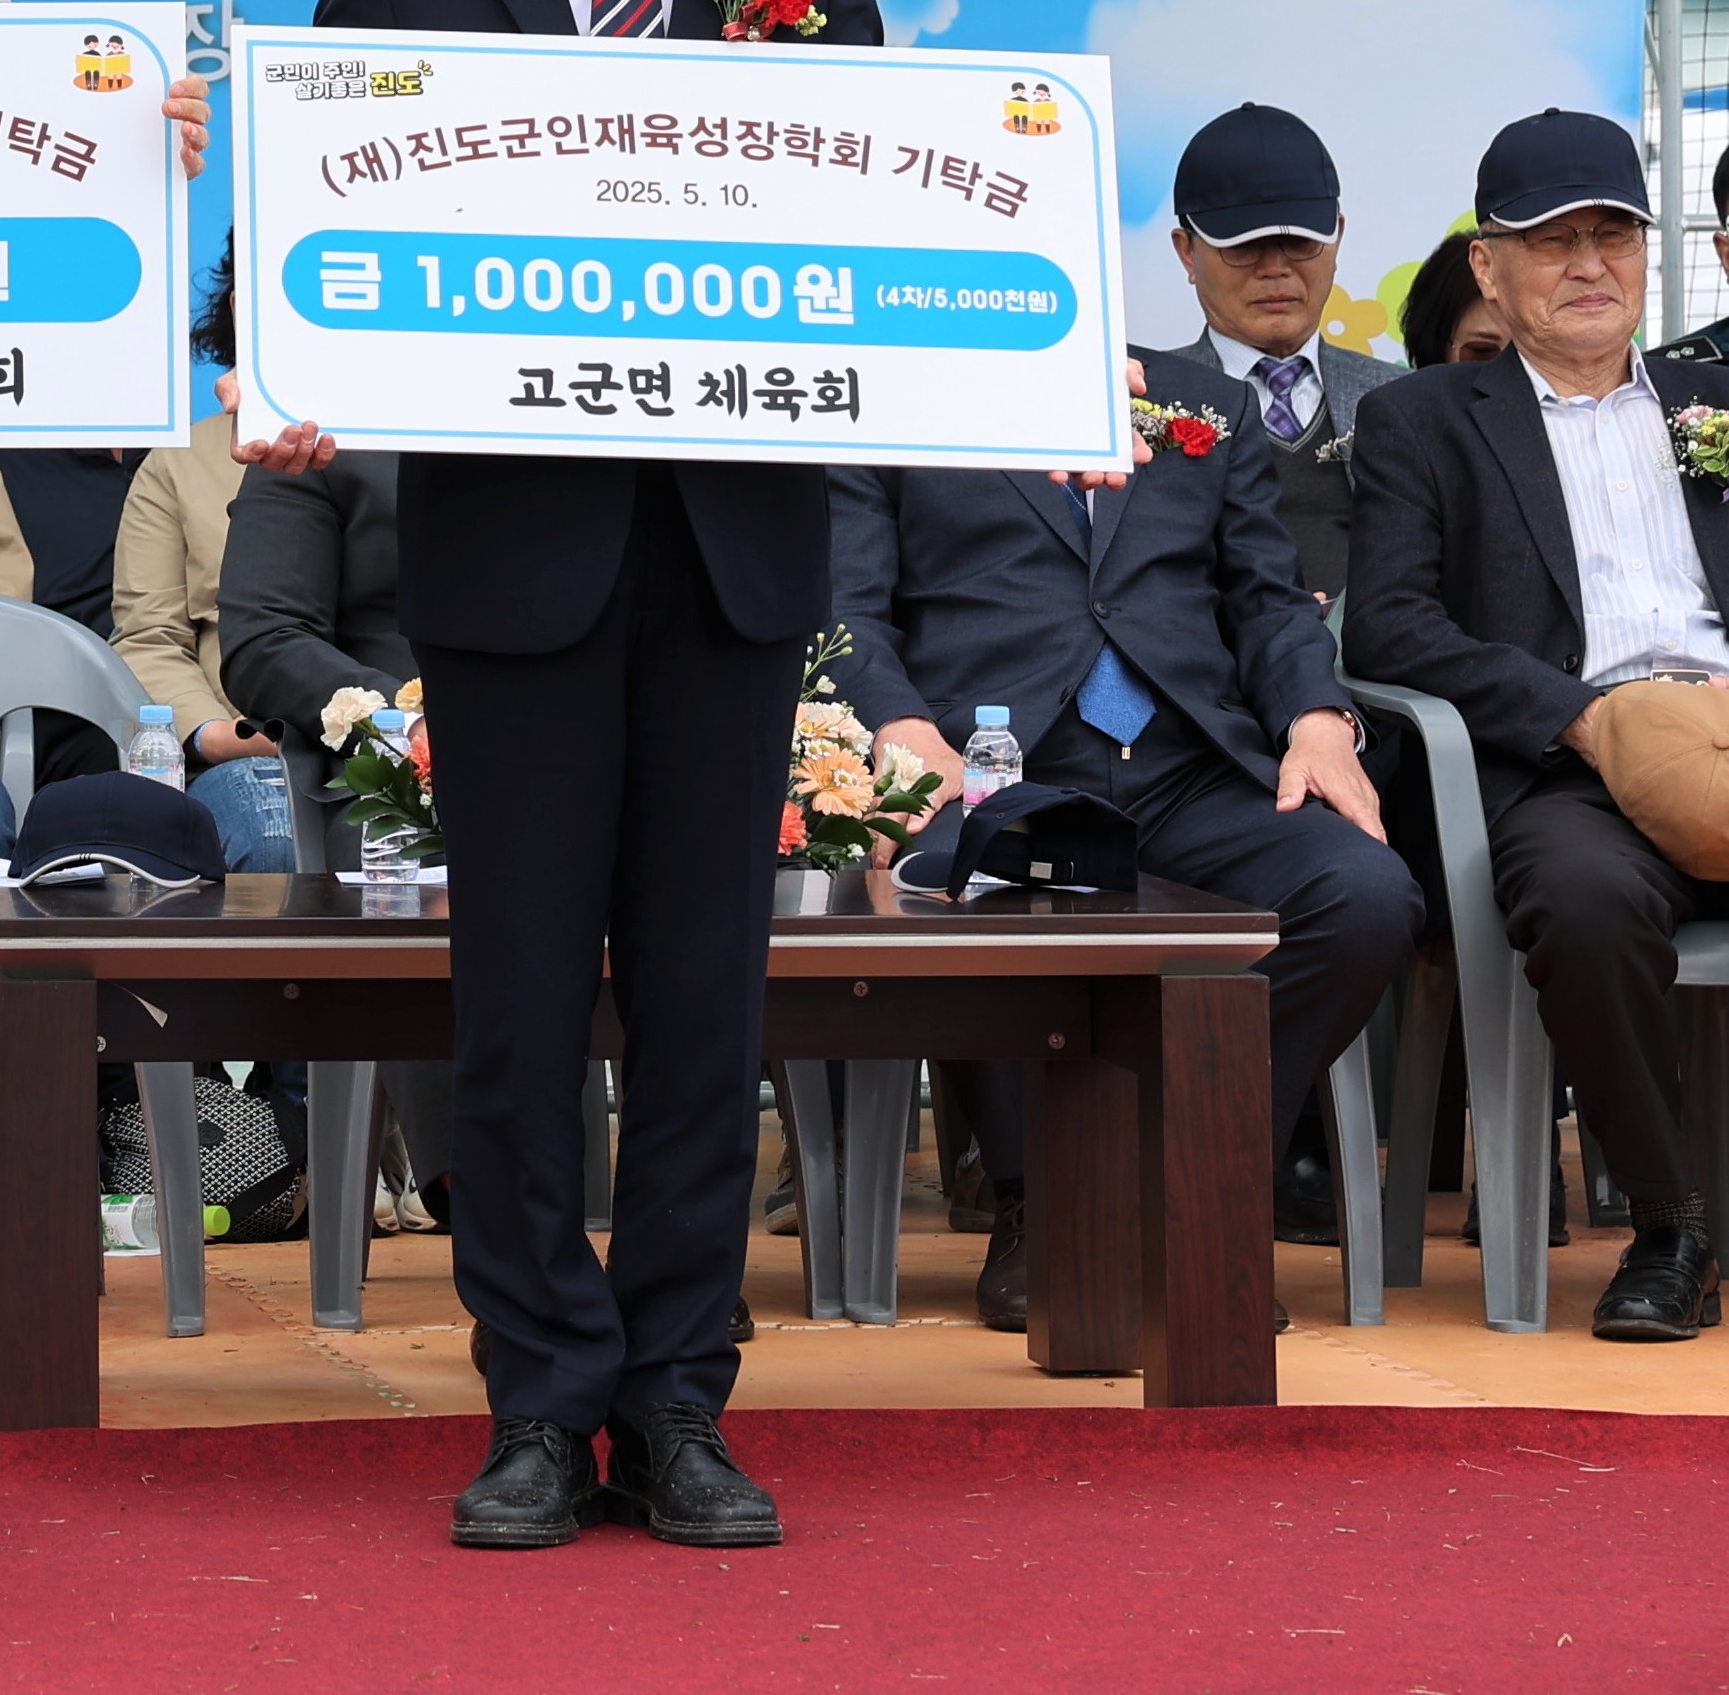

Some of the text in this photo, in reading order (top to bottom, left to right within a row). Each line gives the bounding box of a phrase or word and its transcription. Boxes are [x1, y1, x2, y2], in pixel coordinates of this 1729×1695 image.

[265, 60, 365, 83] 군민이 주인!
[295, 70, 423, 101] 살기좋은 진도
[321, 113, 1028, 218] (재)진도군인재육성장학회 기탁금
[597, 179, 757, 208] 2025. 5. 10.
[319, 250, 1059, 325] 금 1,000,000원 (4차/5,000천원)
[508, 361, 860, 423] 고군면 체육회
